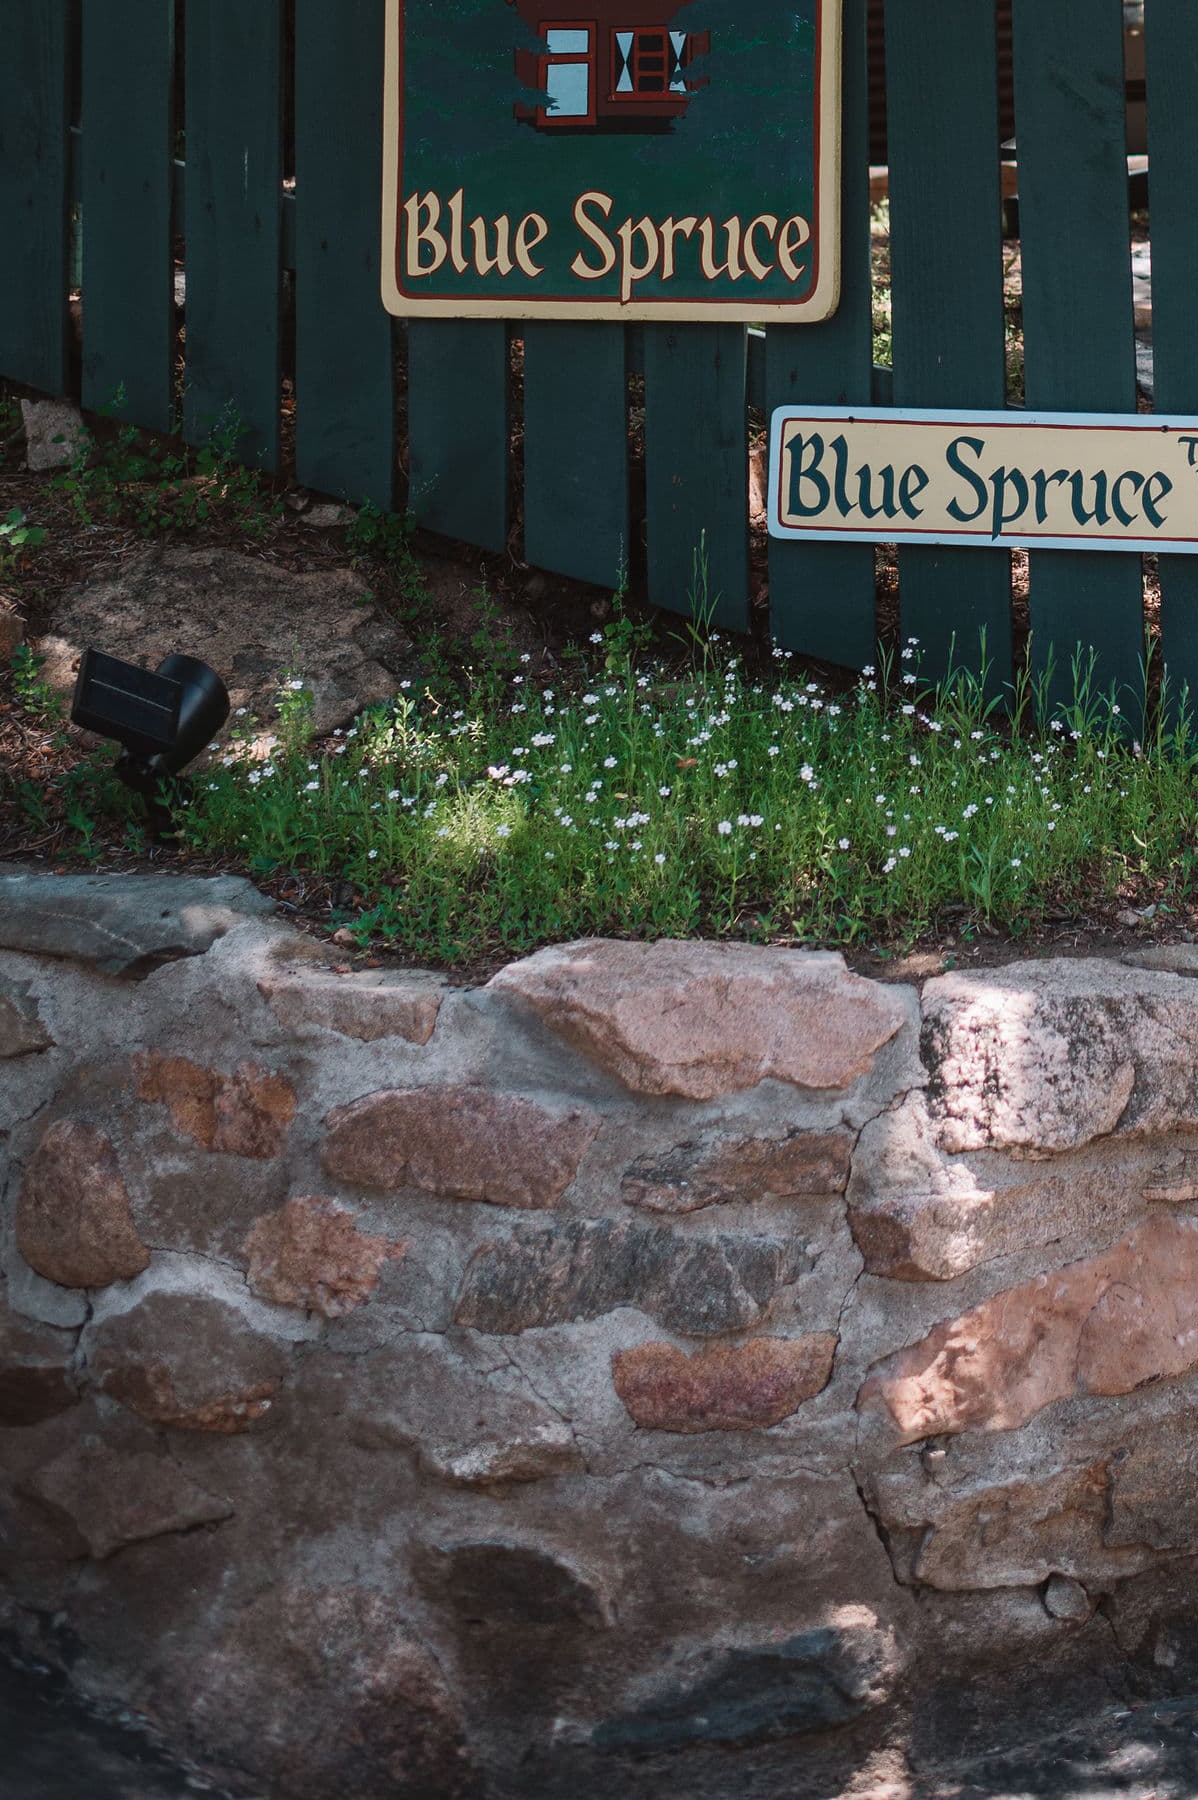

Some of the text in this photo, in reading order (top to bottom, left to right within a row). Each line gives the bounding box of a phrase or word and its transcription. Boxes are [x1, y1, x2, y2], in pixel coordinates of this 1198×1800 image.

[402, 188, 811, 305] Blue Spruce
[785, 432, 930, 520] Blue
[945, 436, 1173, 541] Spruce
